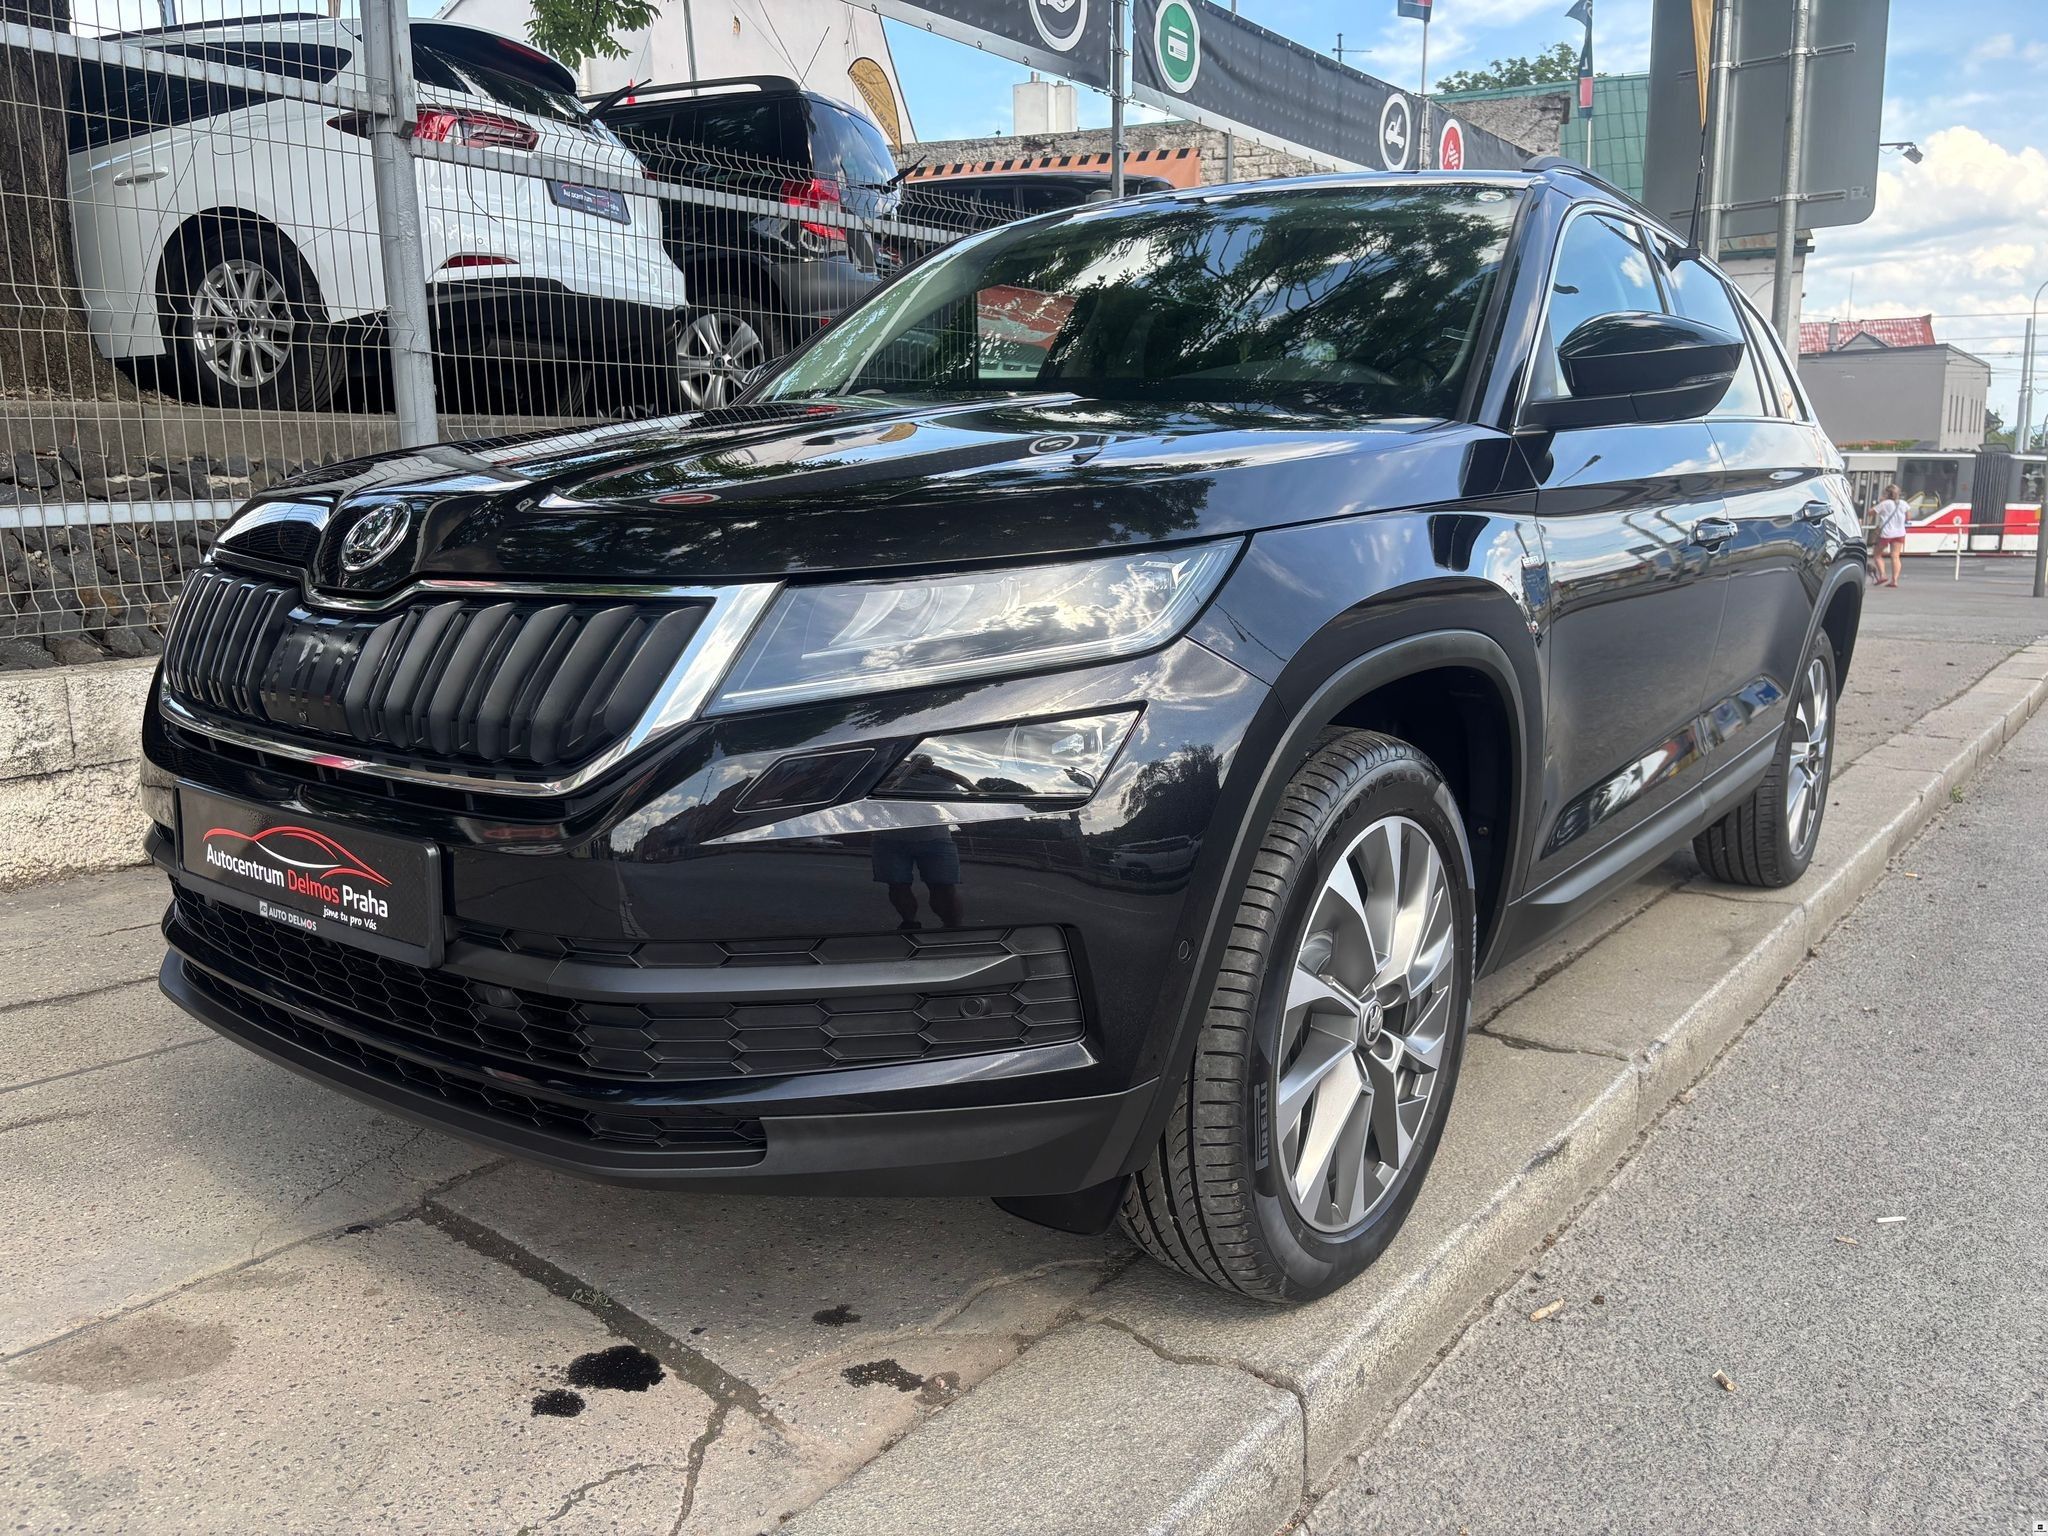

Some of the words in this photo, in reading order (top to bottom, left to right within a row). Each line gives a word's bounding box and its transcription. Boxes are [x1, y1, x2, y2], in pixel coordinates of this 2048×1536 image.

[206, 844, 285, 888] Autocentrum
[288, 869, 339, 904] Delmos
[343, 884, 388, 918] Praha
[269, 907, 286, 921] AUTO
[288, 914, 317, 931] DELMOS
[323, 905, 339, 918] jsme
[341, 913, 348, 922] tu
[350, 916, 362, 926] pro
[364, 918, 377, 930] Vás
[1254, 1081, 1269, 1171] PIRELLI
